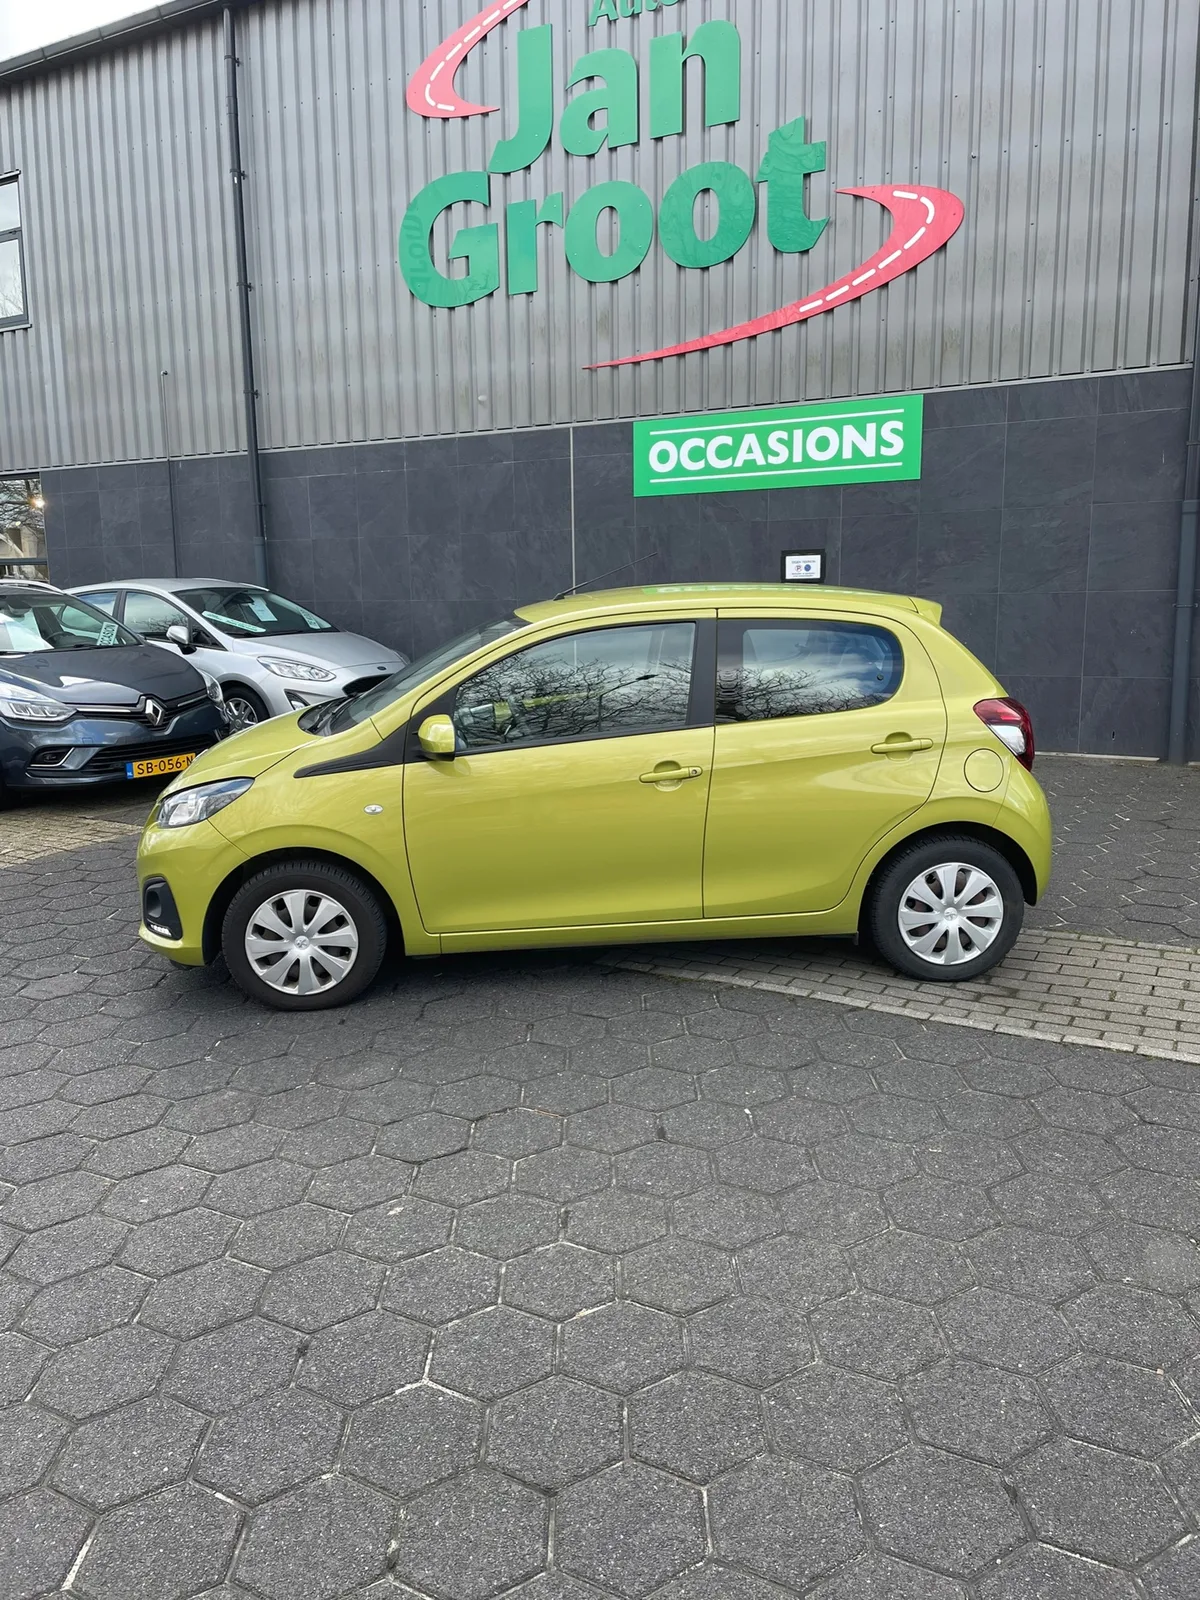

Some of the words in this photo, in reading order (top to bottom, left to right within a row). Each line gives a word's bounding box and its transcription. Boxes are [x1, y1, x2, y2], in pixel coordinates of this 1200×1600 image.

[489, 20, 741, 173] Jan
[398, 116, 830, 308] Groot
[649, 420, 904, 473] OCCASIONS
